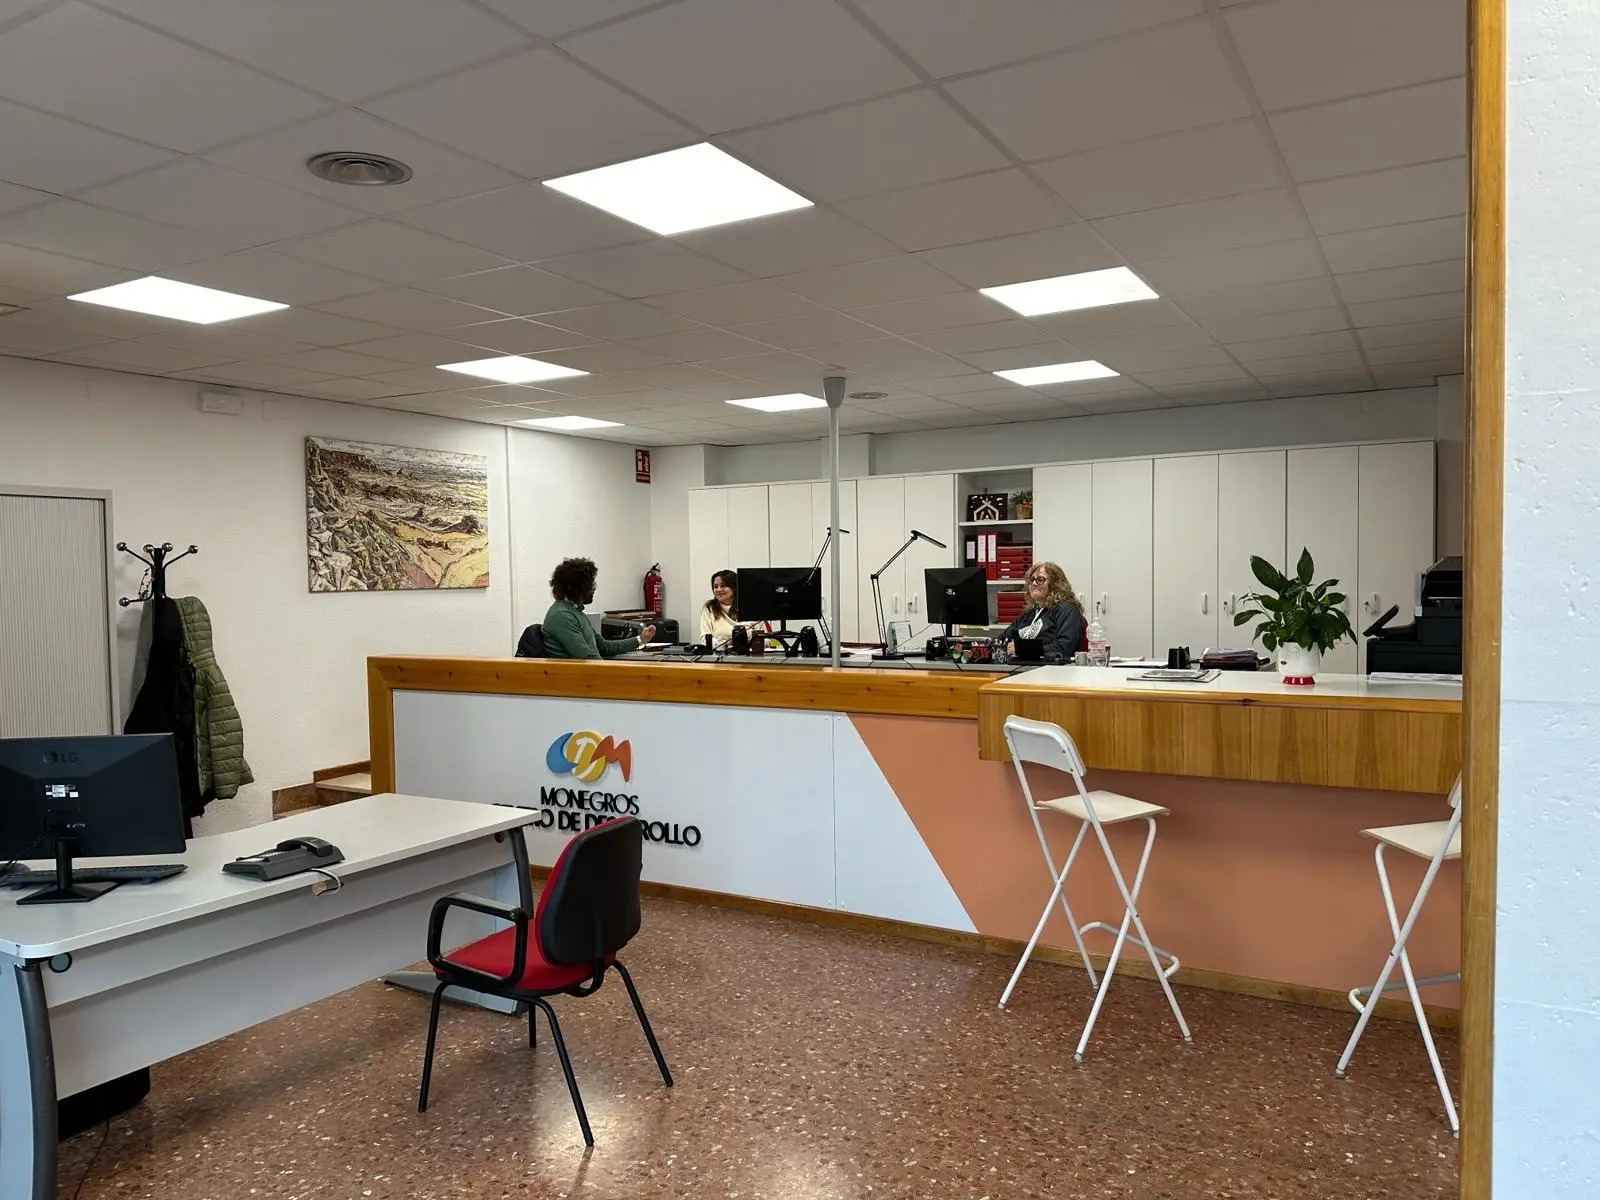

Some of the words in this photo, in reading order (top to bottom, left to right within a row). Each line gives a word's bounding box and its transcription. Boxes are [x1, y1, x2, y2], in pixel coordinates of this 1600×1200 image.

[61, 752, 79, 763] LG
[540, 786, 640, 815] MONEGROS
[557, 811, 581, 831] DE
